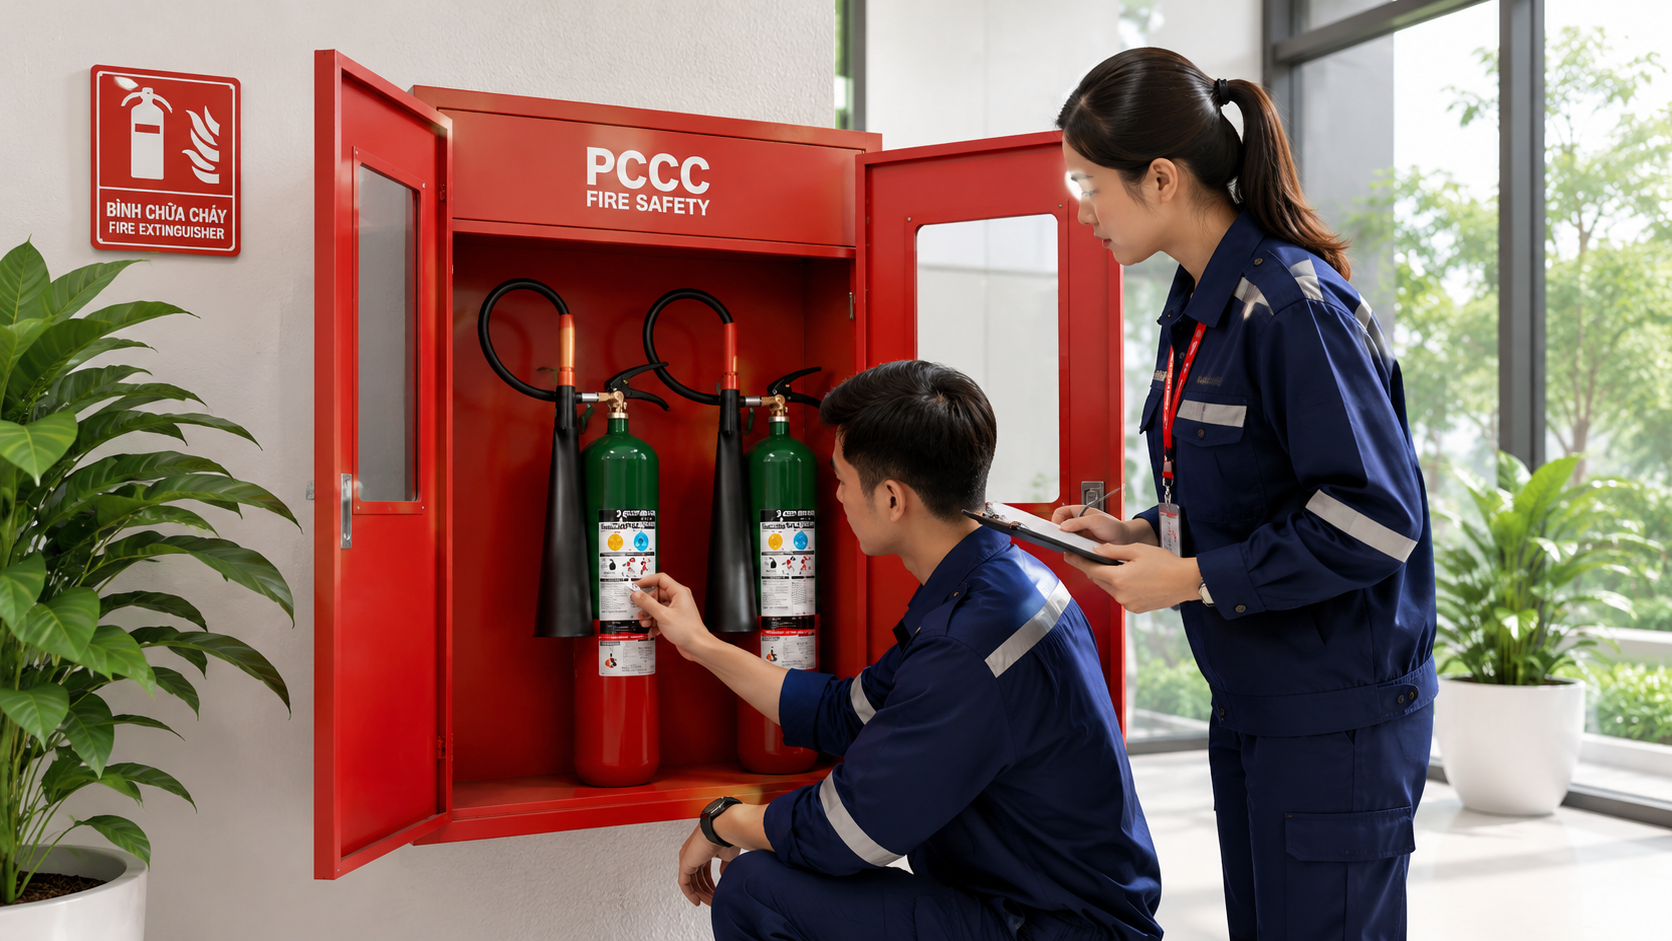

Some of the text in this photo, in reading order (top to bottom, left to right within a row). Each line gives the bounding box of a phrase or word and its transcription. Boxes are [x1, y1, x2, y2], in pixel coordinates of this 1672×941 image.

[587, 147, 710, 194] PCCC
[106, 198, 142, 218] BÌNH
[189, 204, 227, 224] CHÁY
[587, 190, 710, 216] FIRE SAFETY
[109, 221, 224, 239] FIRE EXTINGUISHER
